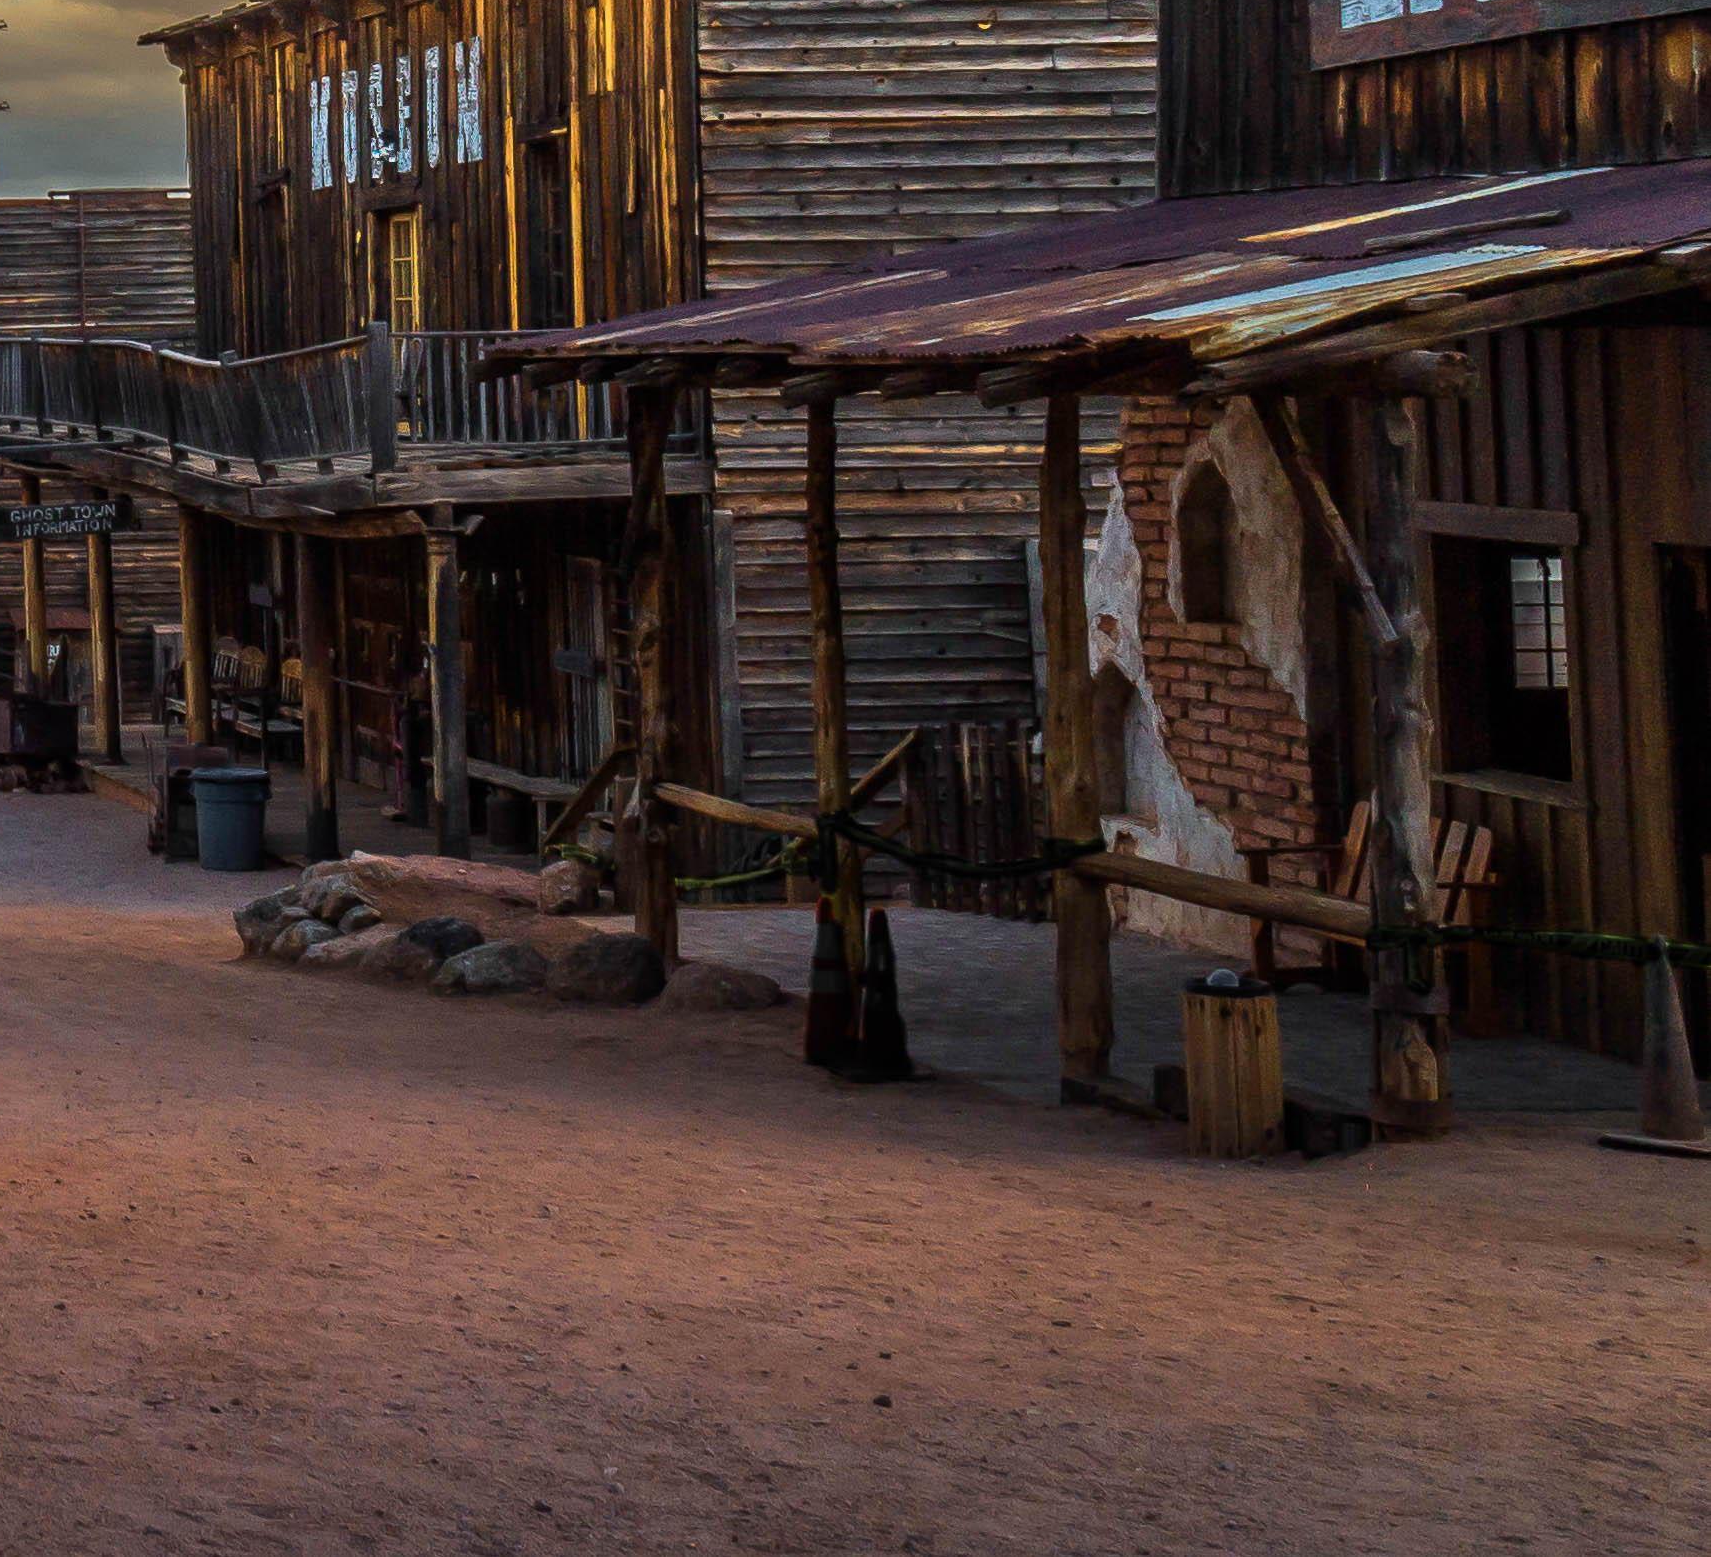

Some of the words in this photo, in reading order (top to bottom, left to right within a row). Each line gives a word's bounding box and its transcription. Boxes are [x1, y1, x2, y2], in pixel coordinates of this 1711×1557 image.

[10, 506, 64, 523] GHOST
[71, 504, 116, 519] TOWN
[16, 518, 113, 537] INFORMATION
